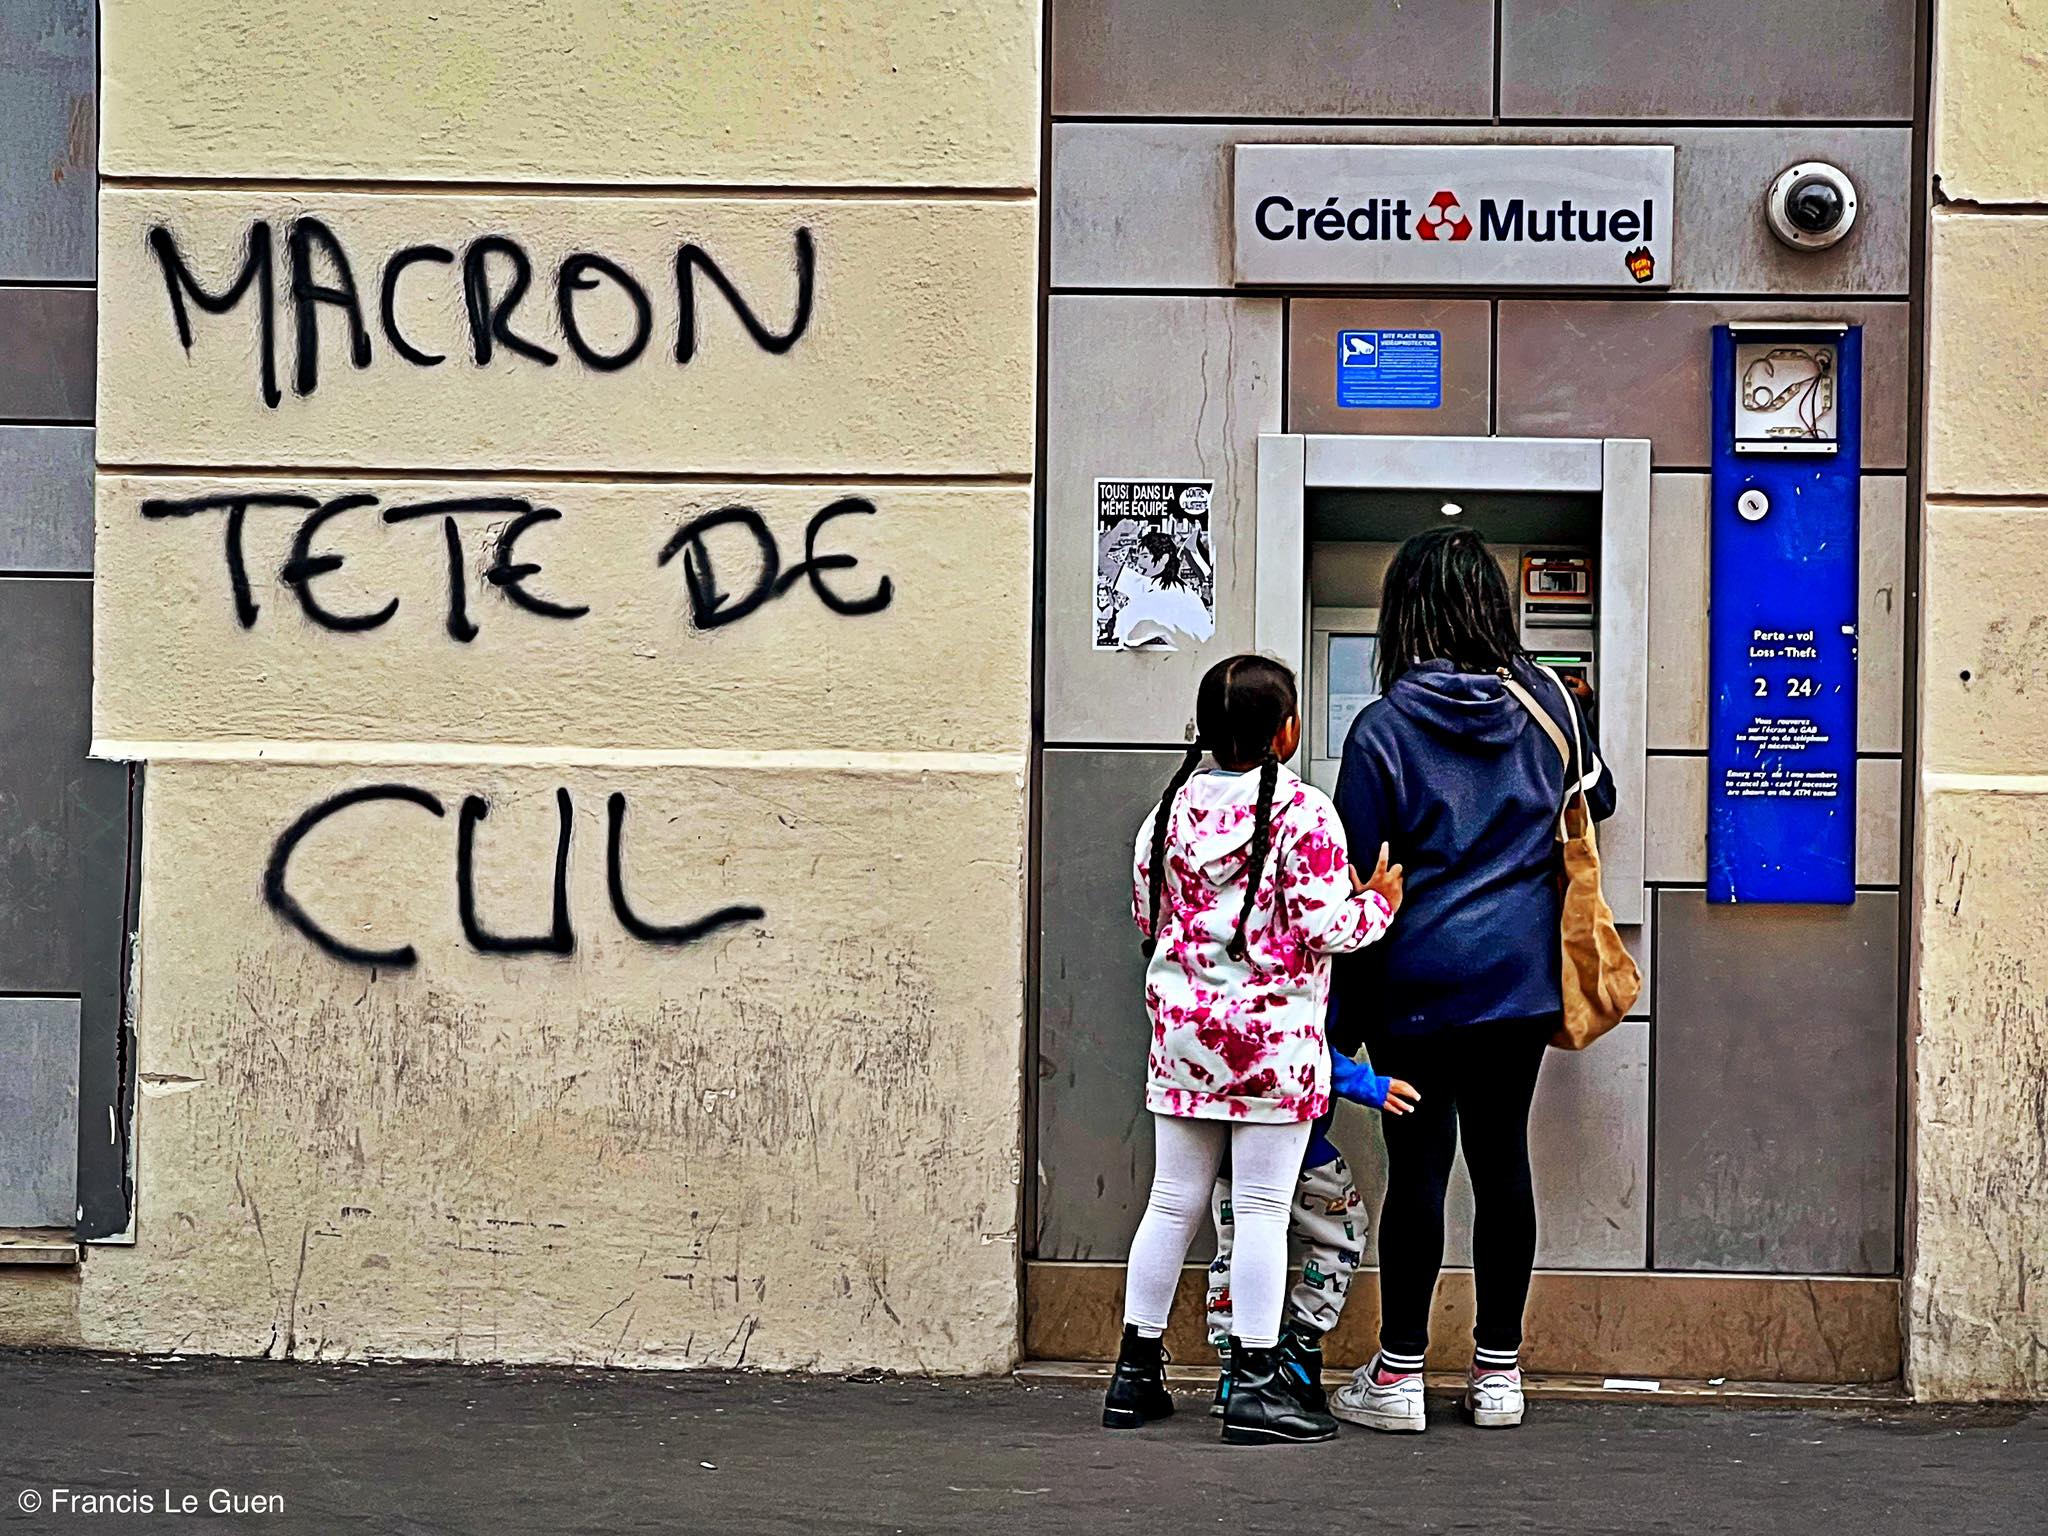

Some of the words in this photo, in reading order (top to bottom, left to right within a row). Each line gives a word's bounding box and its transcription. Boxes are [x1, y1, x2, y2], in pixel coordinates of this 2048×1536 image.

[1255, 196, 1411, 241] Crédit
[1480, 199, 1653, 242] Mutuel
[149, 216, 815, 408] MACRON
[1133, 485, 1161, 500] DANS
[1162, 485, 1175, 500] LA
[1101, 498, 1130, 515] MÊME
[141, 492, 590, 642] TETE
[659, 497, 894, 630] DE
[1753, 630, 1785, 641] Perte
[1796, 631, 1814, 641] vol
[1750, 647, 1775, 658] Loss
[1800, 726, 1818, 734] GAB
[1775, 780, 1793, 788] card
[1793, 788, 1811, 796] ATM
[264, 783, 766, 968] CUL
